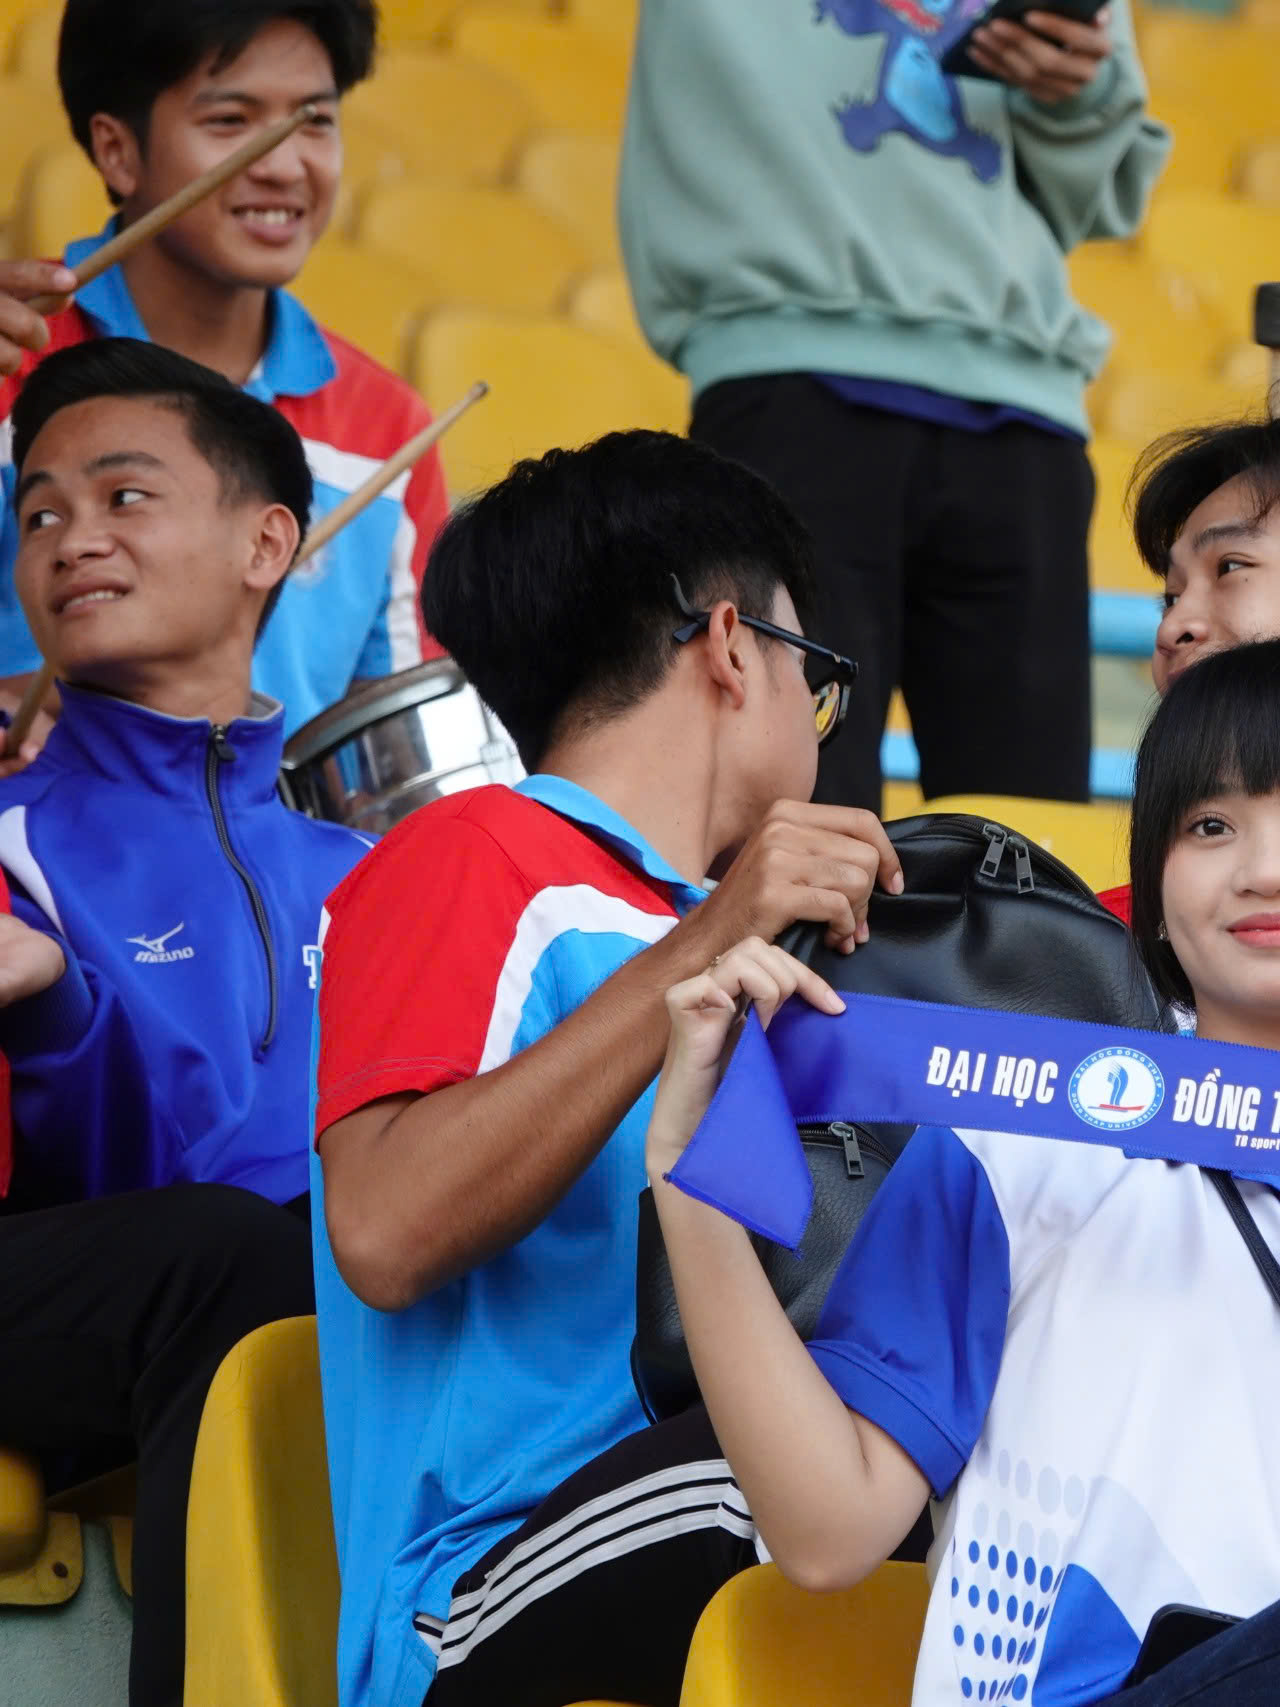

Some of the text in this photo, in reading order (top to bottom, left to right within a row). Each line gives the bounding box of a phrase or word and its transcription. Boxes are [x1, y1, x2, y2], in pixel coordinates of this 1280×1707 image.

[926, 1046, 986, 1098] ĐẠI
[992, 1055, 1058, 1108] HỌC
[1172, 1068, 1261, 1132] ĐỒNG
[1235, 1134, 1280, 1151] TB sport
